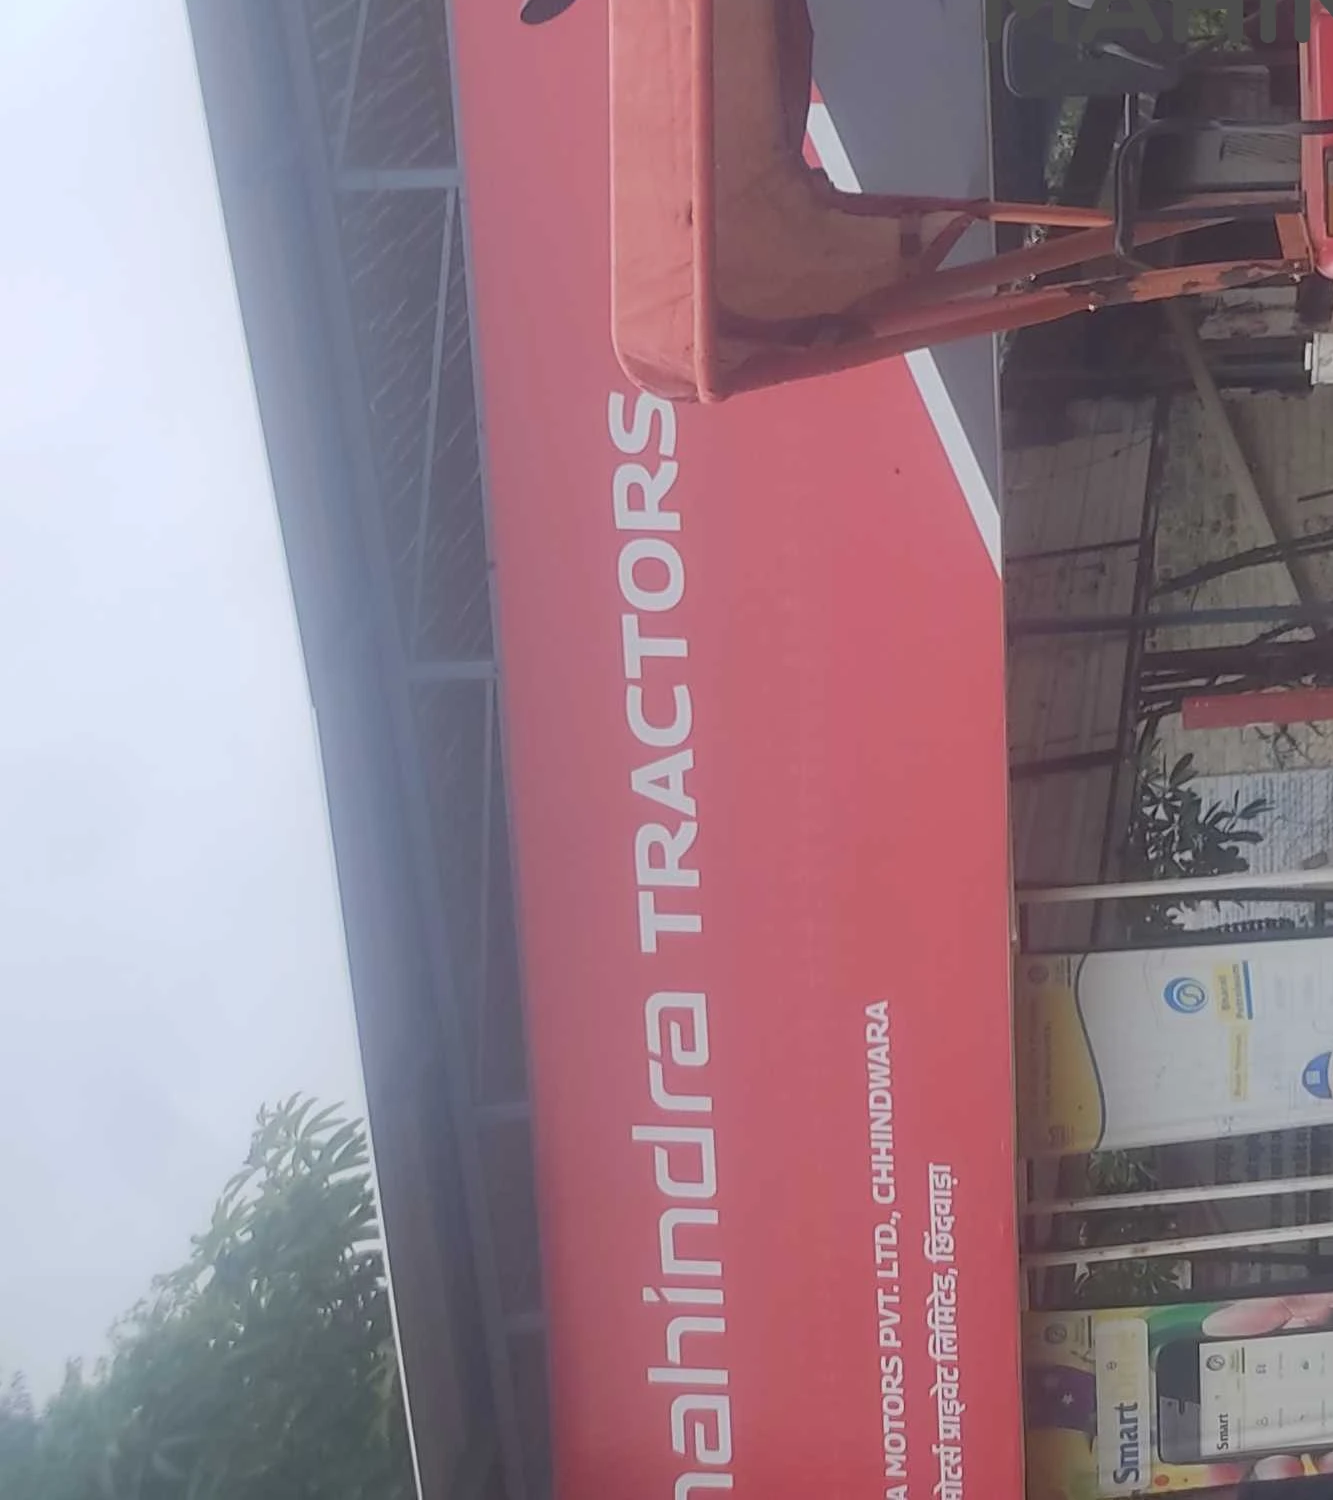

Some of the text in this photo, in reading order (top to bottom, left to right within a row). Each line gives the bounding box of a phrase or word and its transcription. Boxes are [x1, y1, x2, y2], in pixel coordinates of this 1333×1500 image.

[607, 390, 704, 953] TRACTORS
[865, 1000, 897, 1204] CHHINDWARA
[923, 1162, 959, 1263] छिंदवाड़ा
[877, 1285, 903, 1348] PVT.
[926, 1268, 959, 1361] लिमिटेड,
[880, 1356, 907, 1477] MOTORS
[930, 1365, 965, 1440] प्राइवेट
[1112, 1402, 1140, 1484] Smart
[1216, 1413, 1229, 1450] Smart
